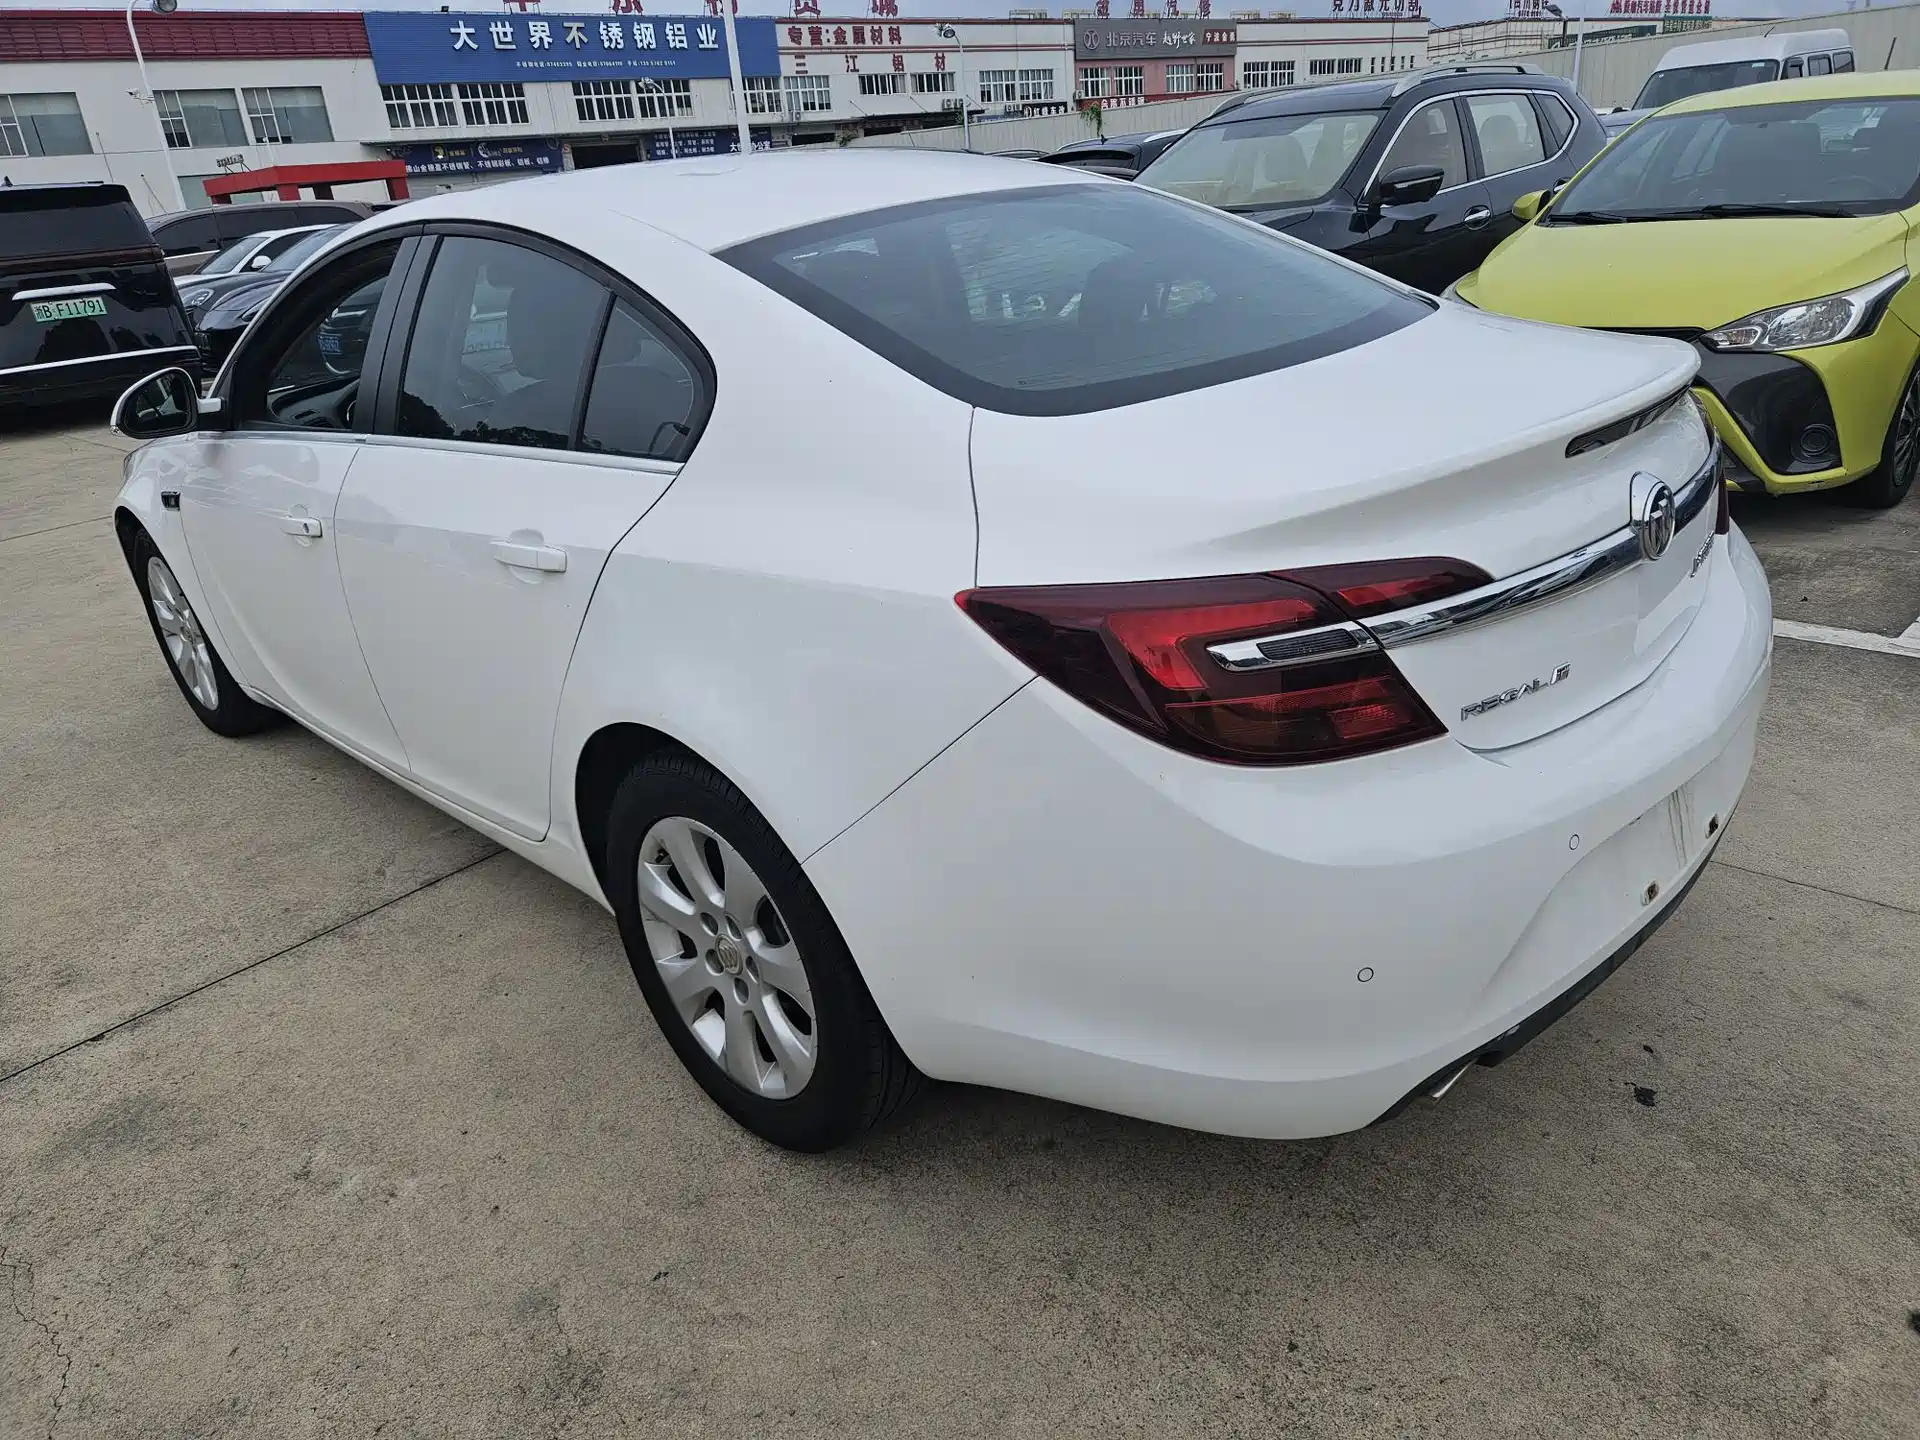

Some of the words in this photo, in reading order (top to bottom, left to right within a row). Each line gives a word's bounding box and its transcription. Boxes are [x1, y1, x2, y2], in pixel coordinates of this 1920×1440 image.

[450, 20, 720, 50] 大世界不锈钢铝业
[788, 25, 902, 46] 专营:金属材料
[1105, 31, 1157, 47] 北京汽车
[1461, 678, 1549, 721] REGAL
